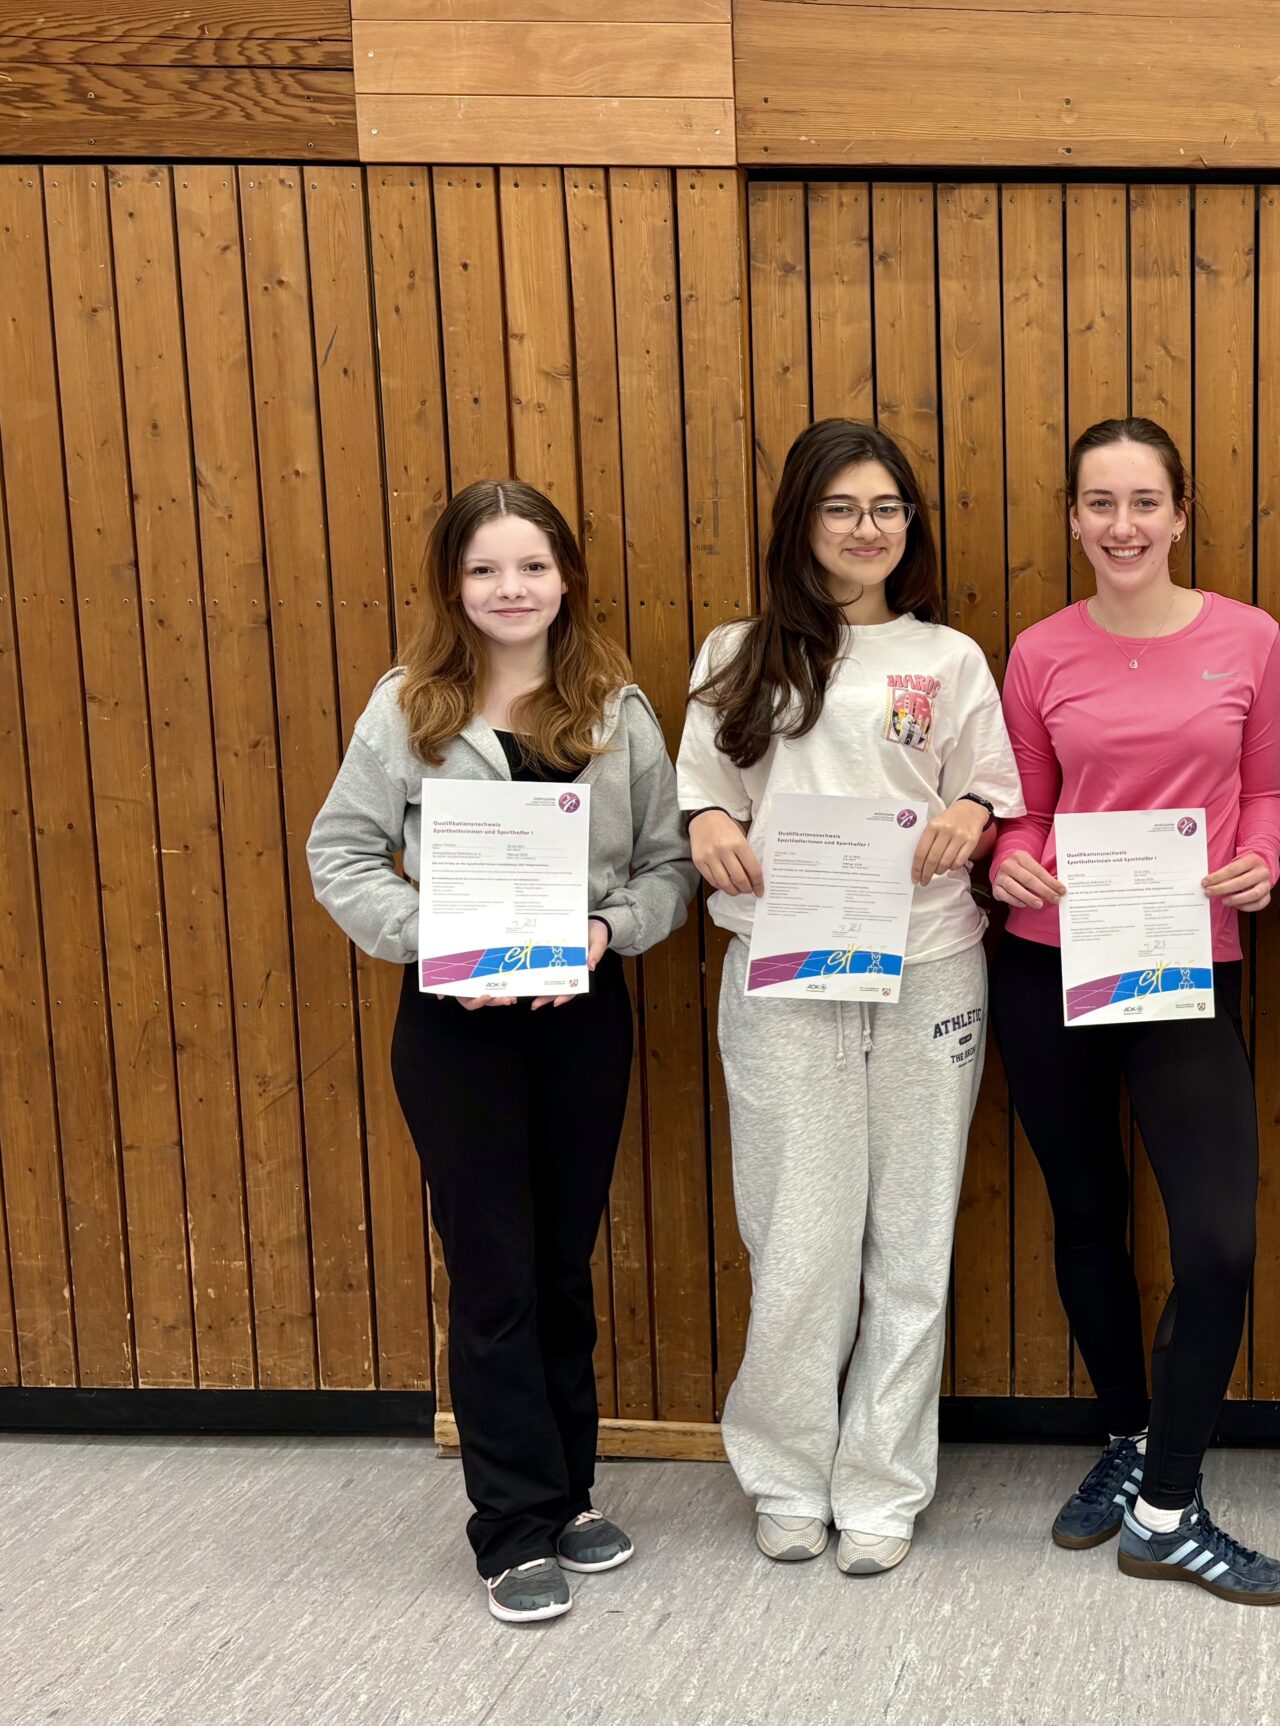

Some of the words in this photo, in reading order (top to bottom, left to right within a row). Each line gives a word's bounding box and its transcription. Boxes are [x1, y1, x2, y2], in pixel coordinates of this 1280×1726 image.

[433, 820, 501, 828] Qualifikationsnachweis
[778, 831, 841, 839] Qualifikationsnachweis
[950, 1052, 964, 1064] THE
